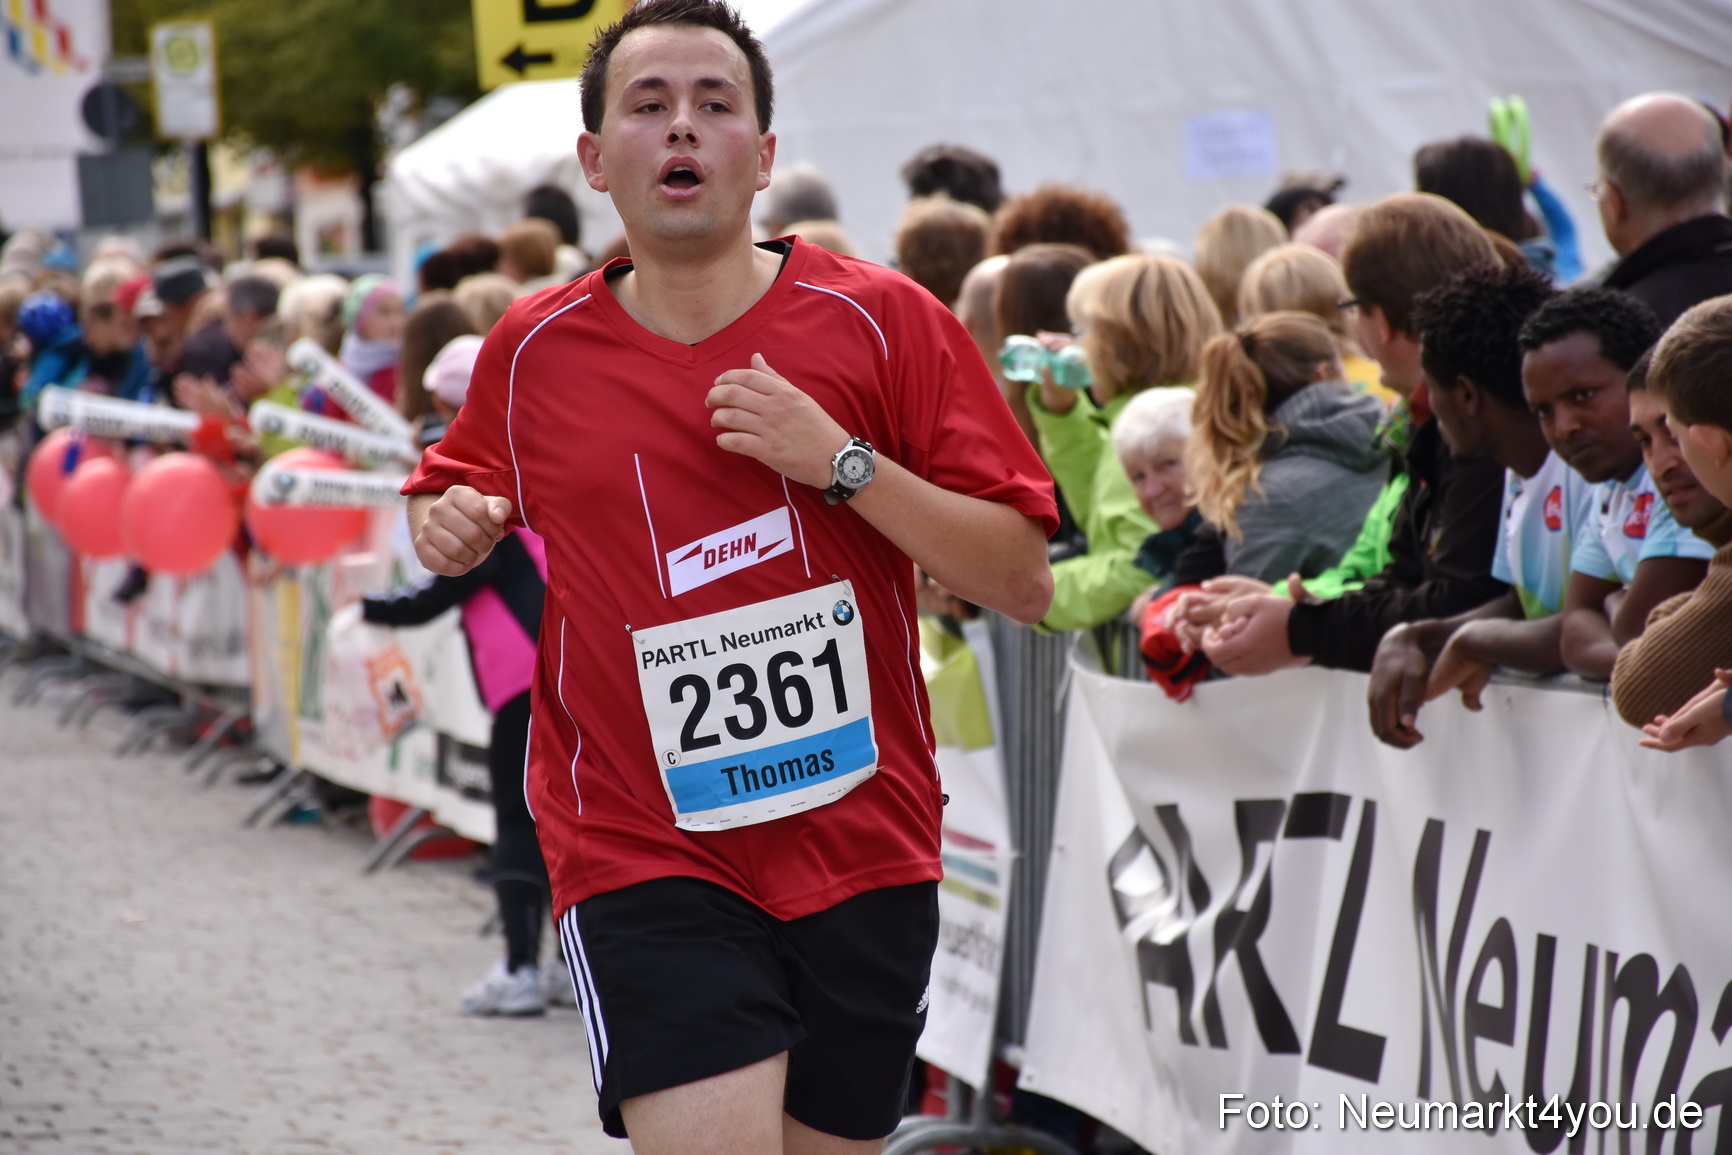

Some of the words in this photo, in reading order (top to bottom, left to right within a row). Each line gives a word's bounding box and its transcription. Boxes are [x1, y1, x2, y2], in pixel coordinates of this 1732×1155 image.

[704, 532, 757, 570] DEHN
[642, 640, 717, 669] PARTL
[720, 612, 826, 653] Neumarkt
[669, 638, 849, 753] 2361
[720, 749, 835, 796] Thomas
